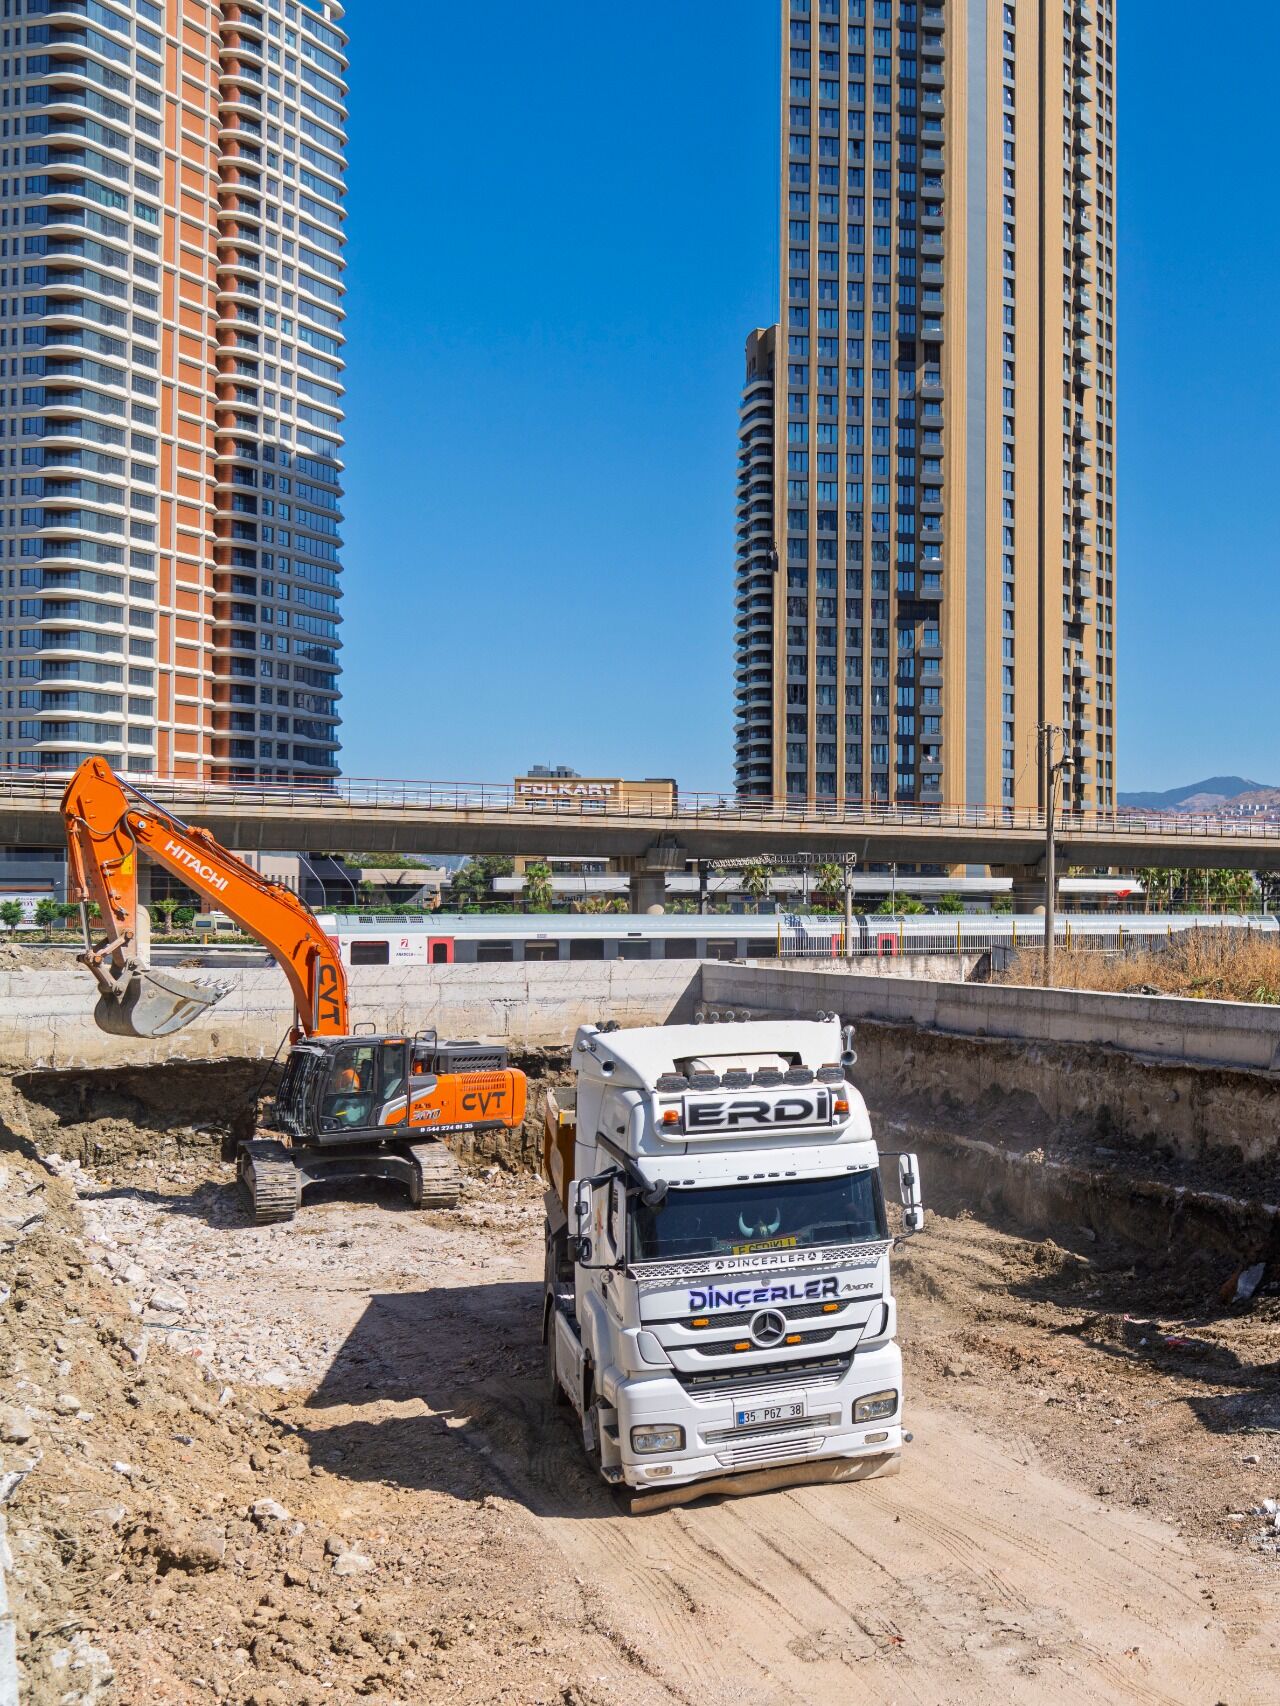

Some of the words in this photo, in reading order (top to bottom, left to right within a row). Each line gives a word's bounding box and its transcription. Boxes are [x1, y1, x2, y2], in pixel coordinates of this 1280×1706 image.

[164, 840, 229, 891] HITACHI
[319, 964, 341, 1026] CVT
[462, 1091, 507, 1118] CVT
[688, 1091, 828, 1127] ERDİ
[689, 1276, 840, 1312] DİNÇERLER
[744, 1411, 756, 1423] 35
[764, 1407, 782, 1420] PGZ
[790, 1404, 802, 1416] 38
